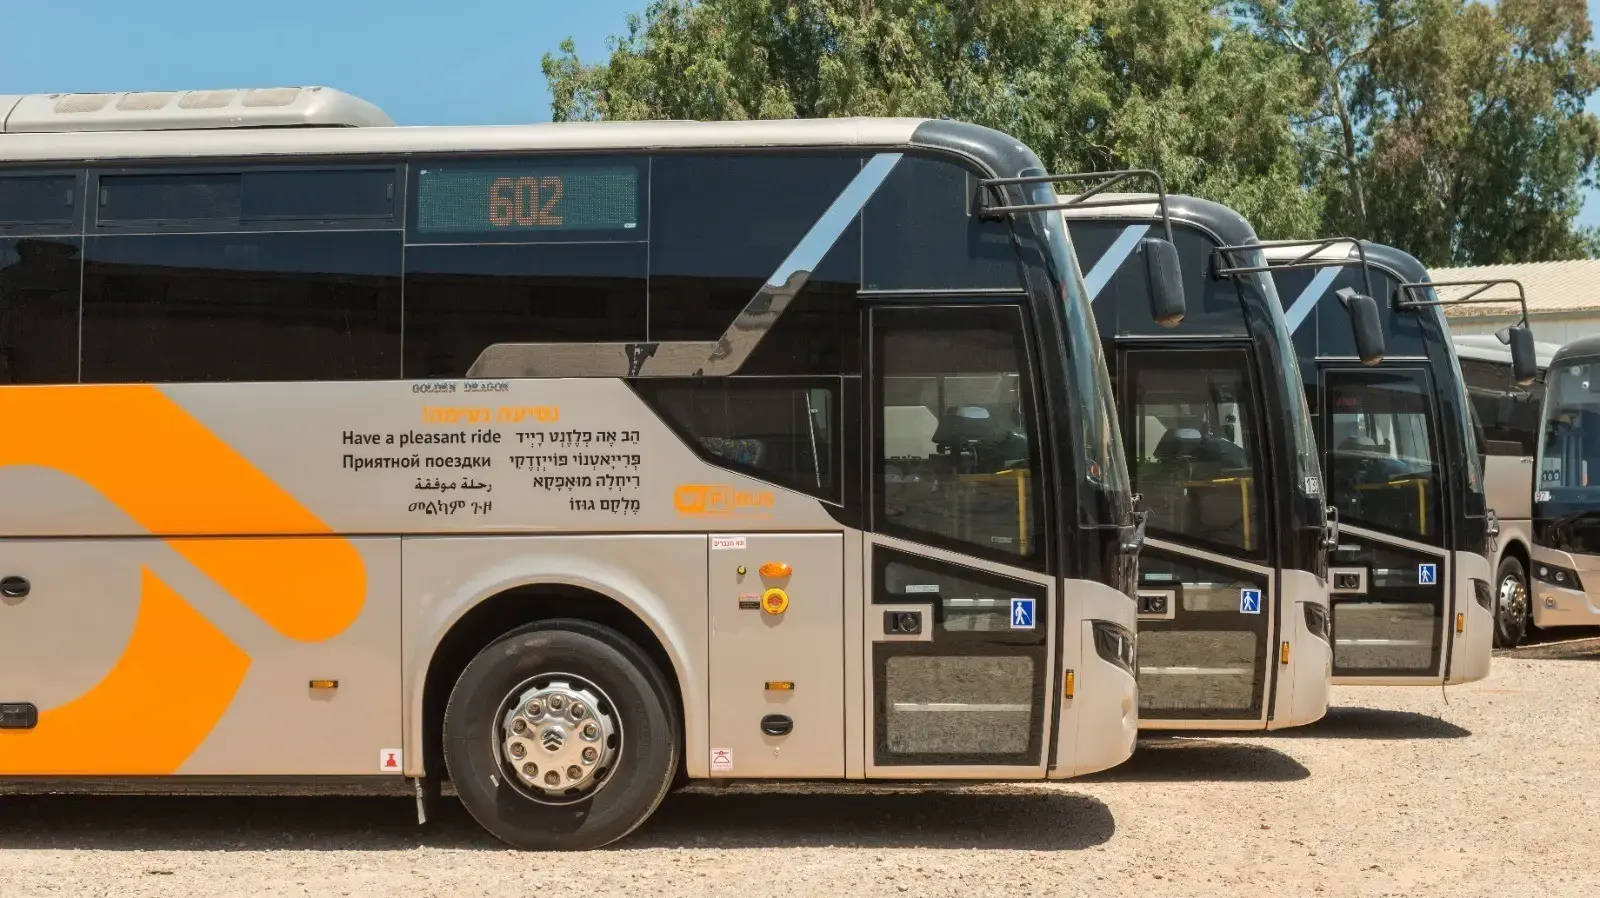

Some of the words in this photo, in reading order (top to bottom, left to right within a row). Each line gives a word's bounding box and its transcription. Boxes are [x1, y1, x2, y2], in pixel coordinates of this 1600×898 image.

[489, 176, 563, 226] 602
[342, 430, 381, 445] Have
[385, 432, 394, 444] a
[399, 429, 466, 448] pleasant
[471, 429, 501, 443] ride
[342, 453, 420, 471] Приятной
[425, 456, 491, 469] поездки
[414, 477, 457, 493] موفقة
[460, 477, 492, 493] رحلة
[408, 499, 466, 515] መልካም
[471, 500, 492, 515] ጉዞ
